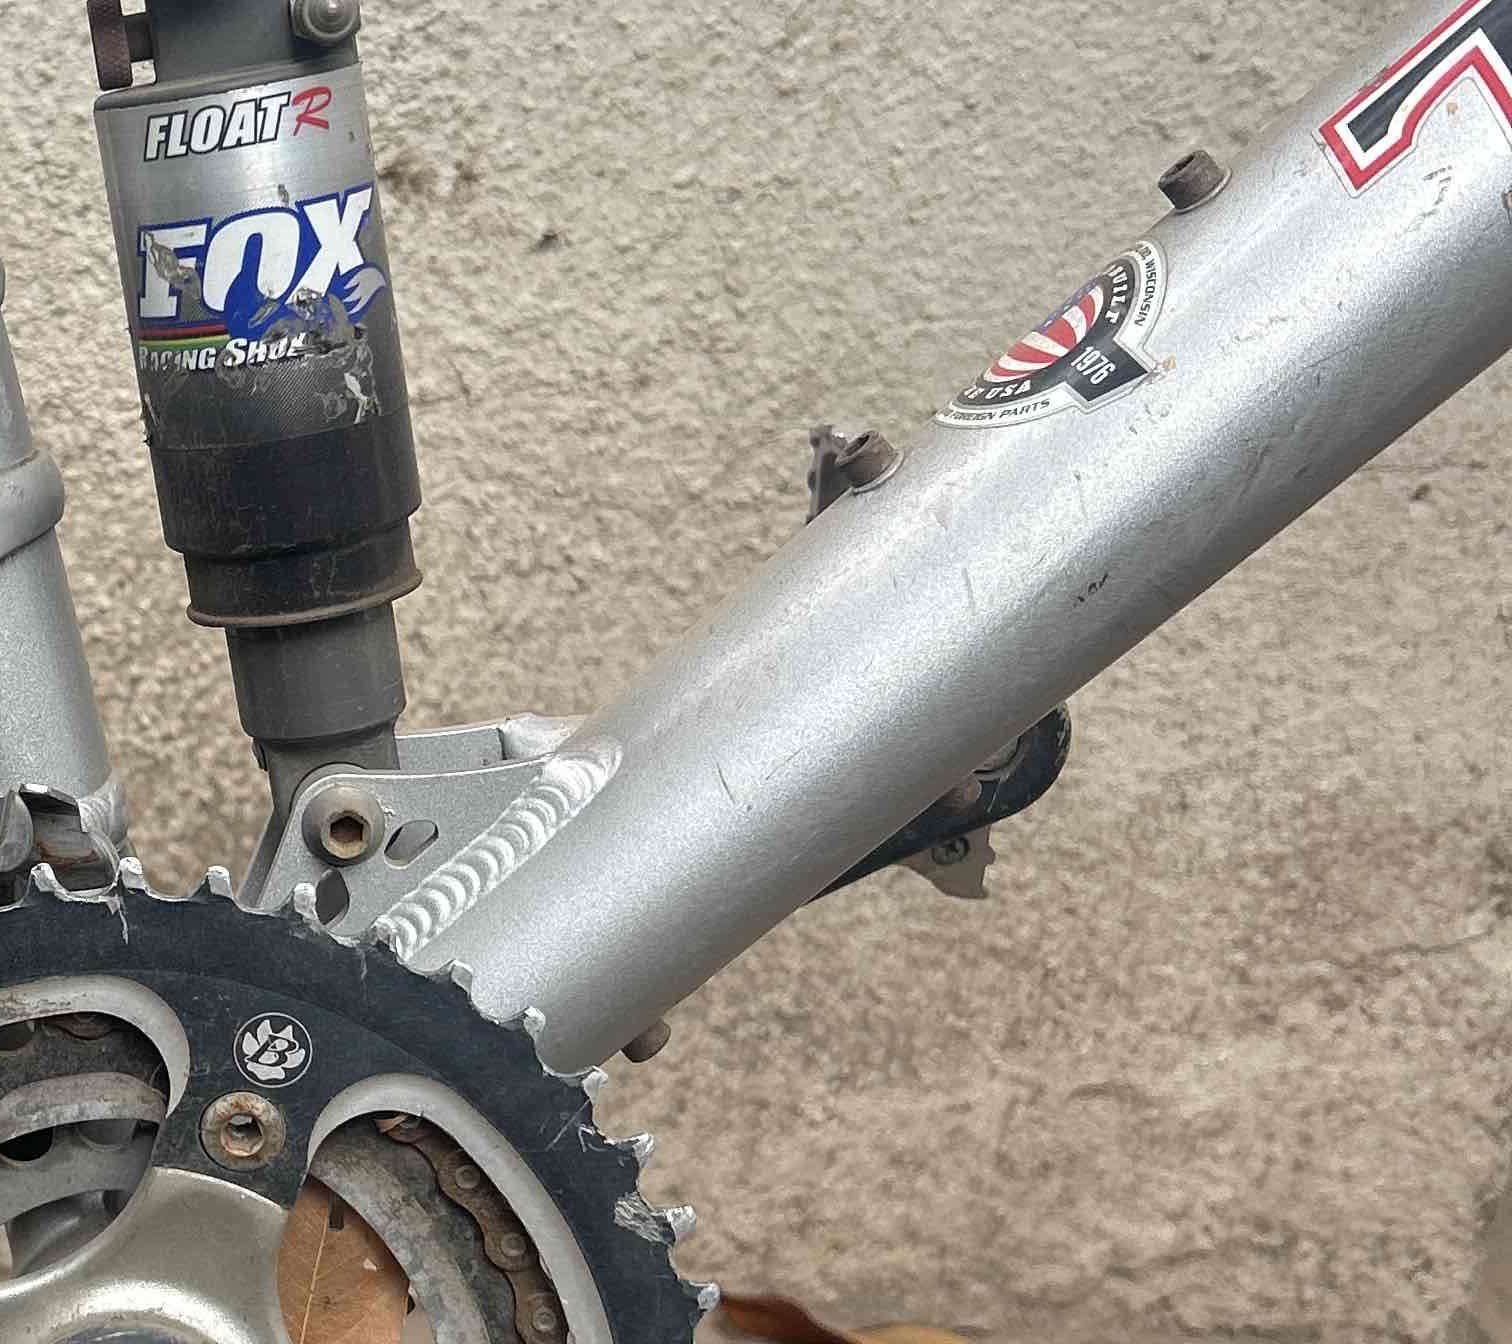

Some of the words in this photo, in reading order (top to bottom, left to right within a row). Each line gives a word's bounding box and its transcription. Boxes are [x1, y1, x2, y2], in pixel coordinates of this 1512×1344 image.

[143, 91, 291, 162] FLOAT
[290, 85, 333, 136] R
[137, 183, 374, 326] FOX
[1133, 258, 1158, 327] WISCONSIN
[984, 379, 1032, 399] USA
[1070, 346, 1117, 386] 1976
[999, 398, 1051, 418] PARTS
